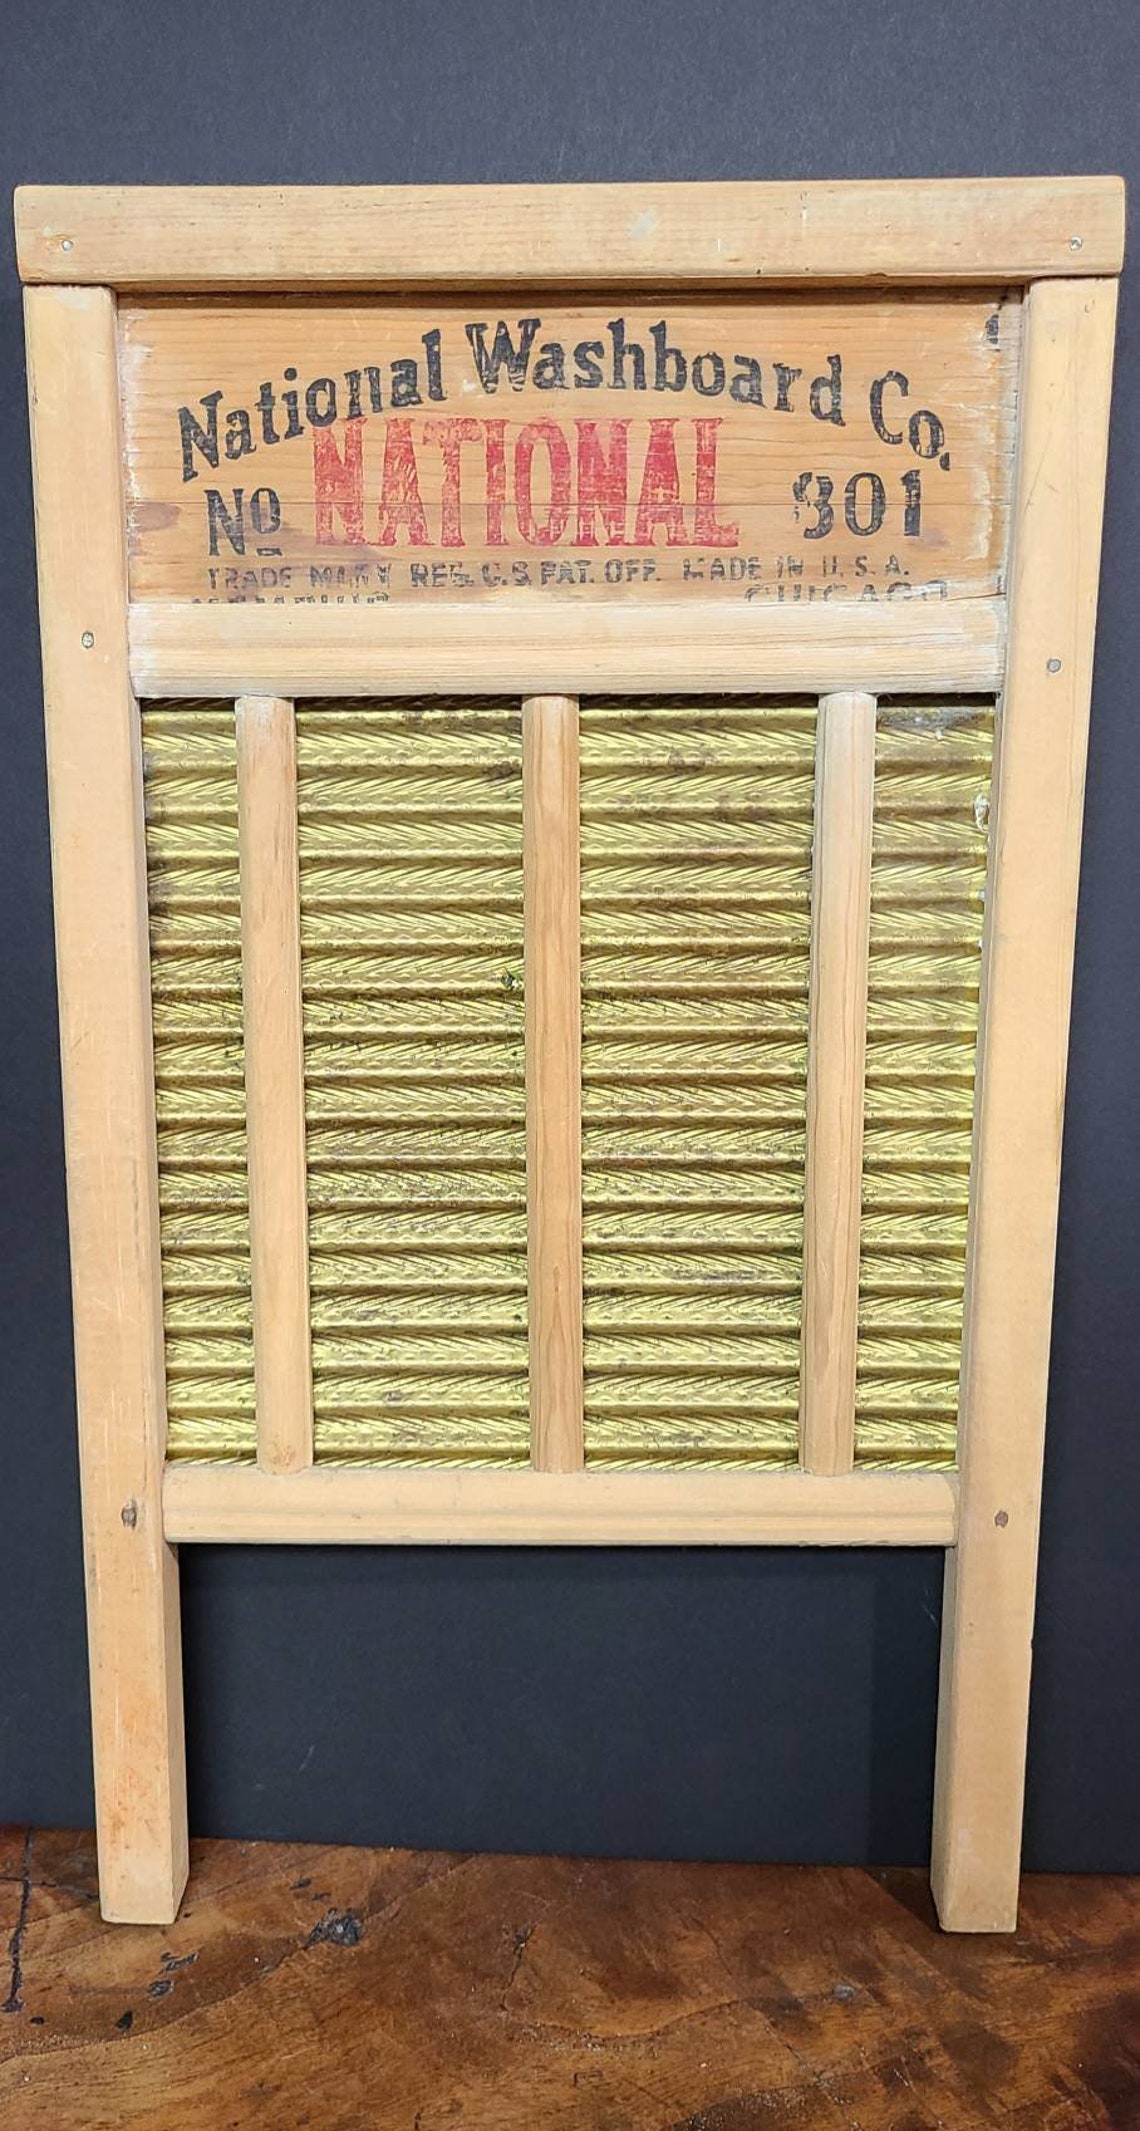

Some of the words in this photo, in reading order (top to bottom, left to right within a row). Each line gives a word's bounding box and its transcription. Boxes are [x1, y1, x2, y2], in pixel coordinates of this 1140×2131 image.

[178, 329, 448, 482] National
[465, 317, 845, 427] Washboard
[868, 370, 951, 472] Co.
[313, 416, 740, 548] NATIONAL
